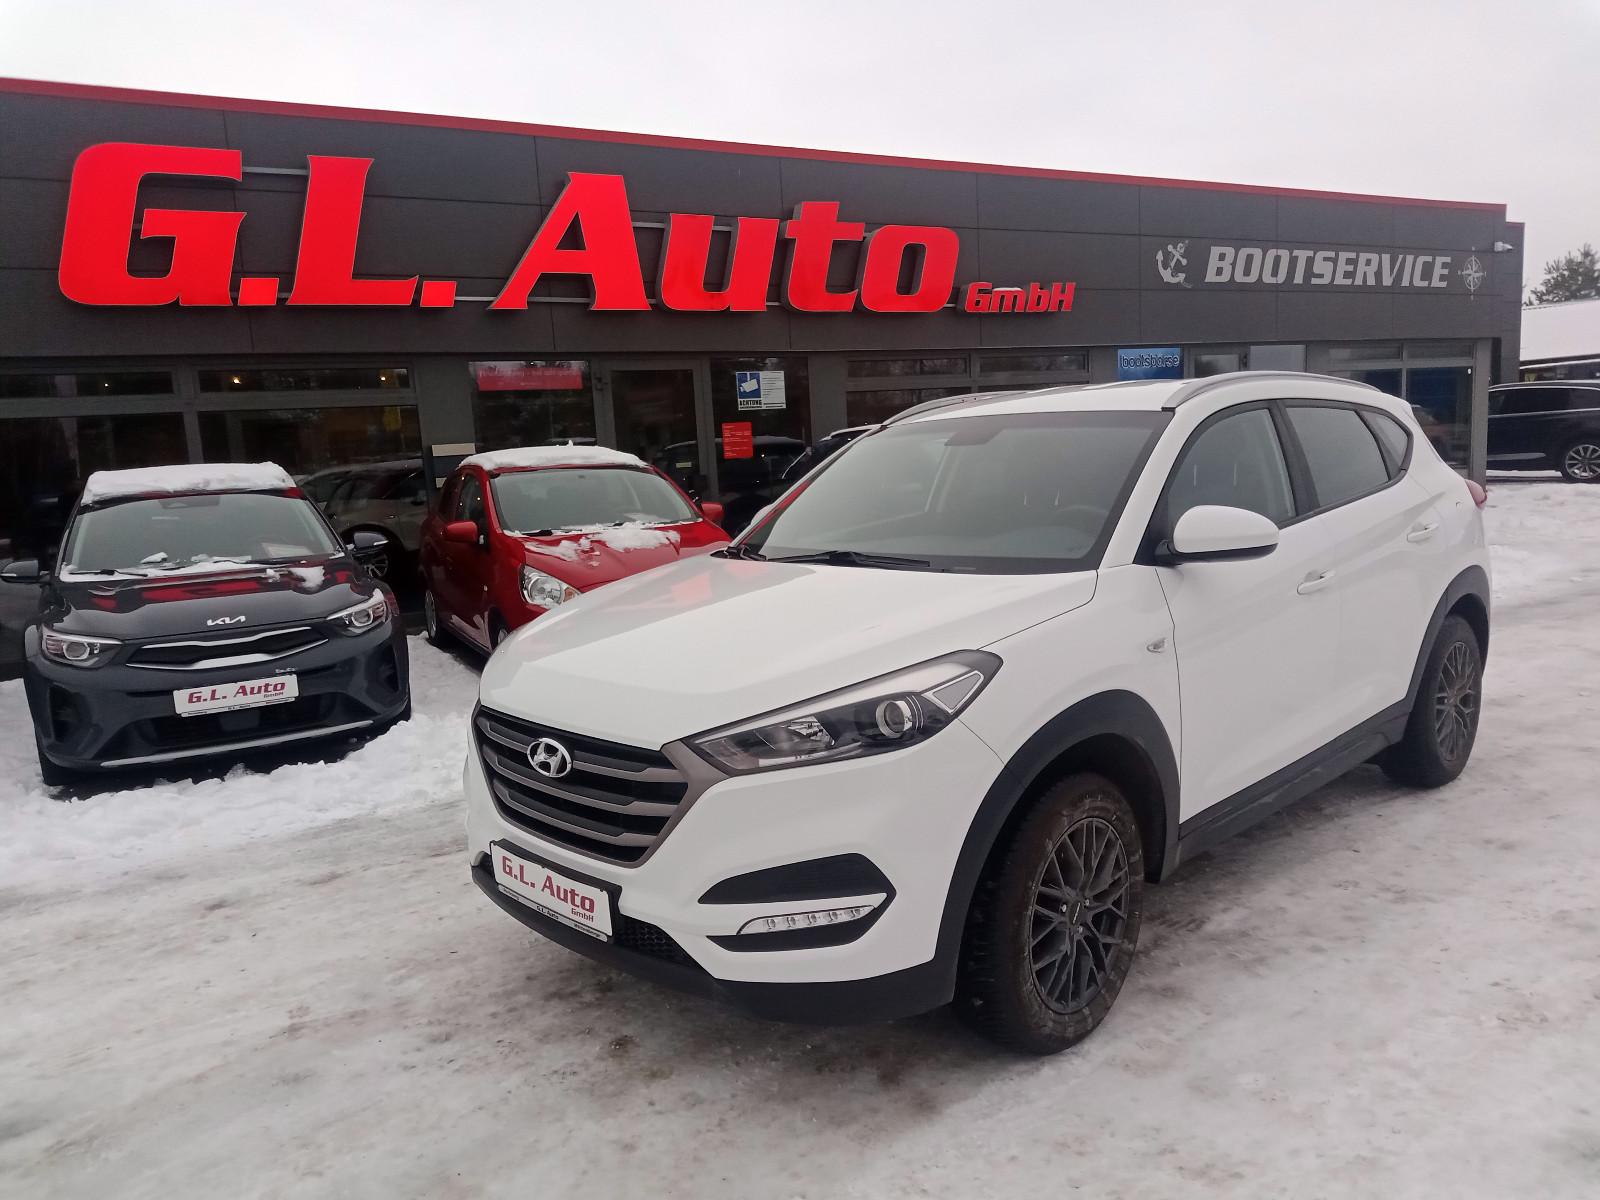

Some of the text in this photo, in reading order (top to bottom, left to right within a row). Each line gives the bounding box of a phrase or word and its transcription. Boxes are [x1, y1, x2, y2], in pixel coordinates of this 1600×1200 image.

[58, 141, 1076, 314] G.L. Auto GmbH
[1204, 245, 1451, 288] BOOTSERVICE
[188, 682, 286, 704] G.L. Auto
[502, 855, 595, 914] G.L. Auto
[571, 907, 594, 923] GmbH
